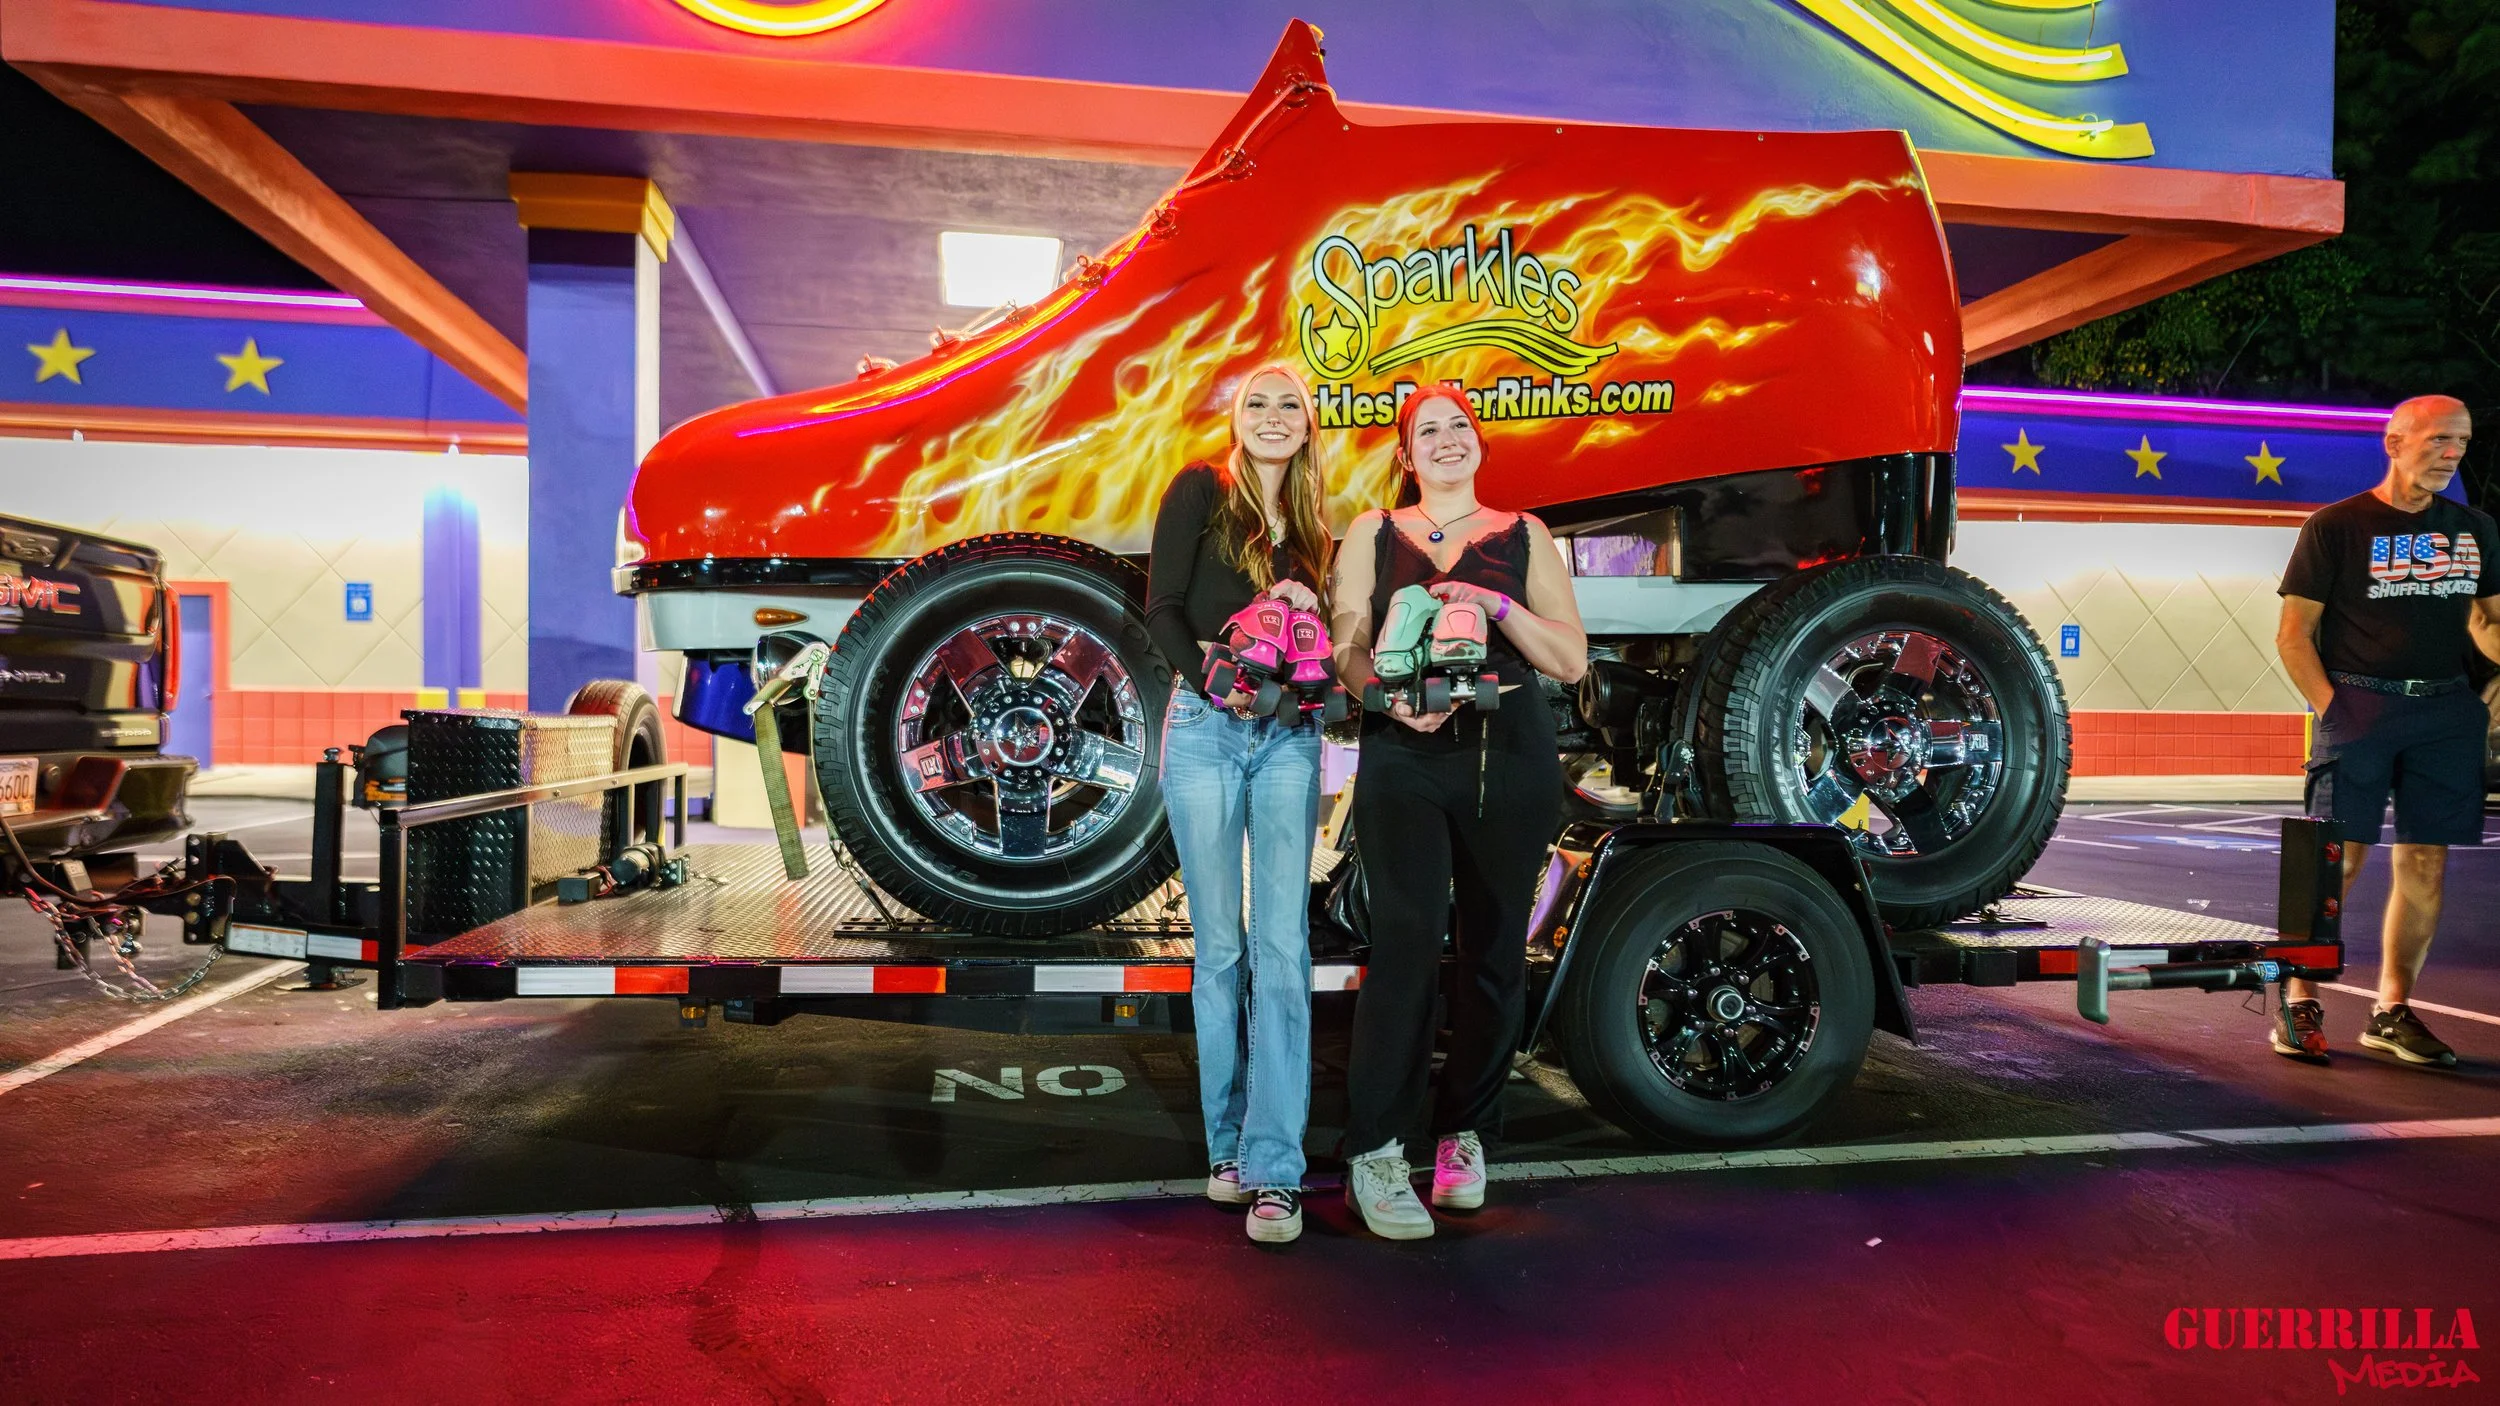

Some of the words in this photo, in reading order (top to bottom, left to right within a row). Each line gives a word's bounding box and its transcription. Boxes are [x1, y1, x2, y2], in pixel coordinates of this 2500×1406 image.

[1300, 224, 1581, 379] Sparkles
[2371, 533, 2481, 581] USA
[2368, 579, 2430, 599] SHUFFLE
[931, 1065, 1127, 1102] NO
